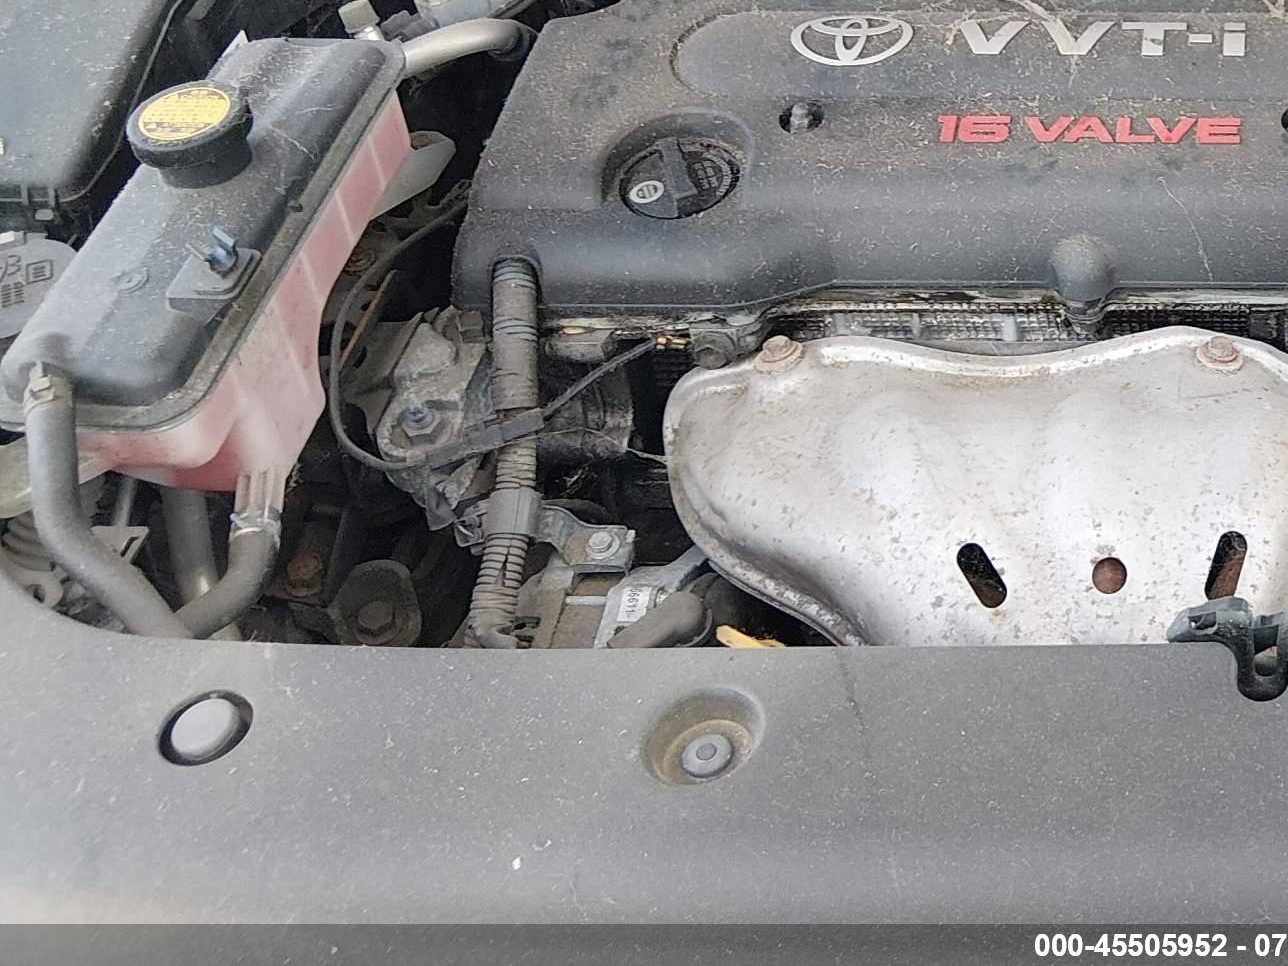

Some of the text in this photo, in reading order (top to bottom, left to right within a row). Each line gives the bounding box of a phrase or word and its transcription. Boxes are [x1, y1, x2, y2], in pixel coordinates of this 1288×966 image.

[959, 21, 1247, 57] VVT-i
[937, 115, 1242, 144] 16 VALVE
